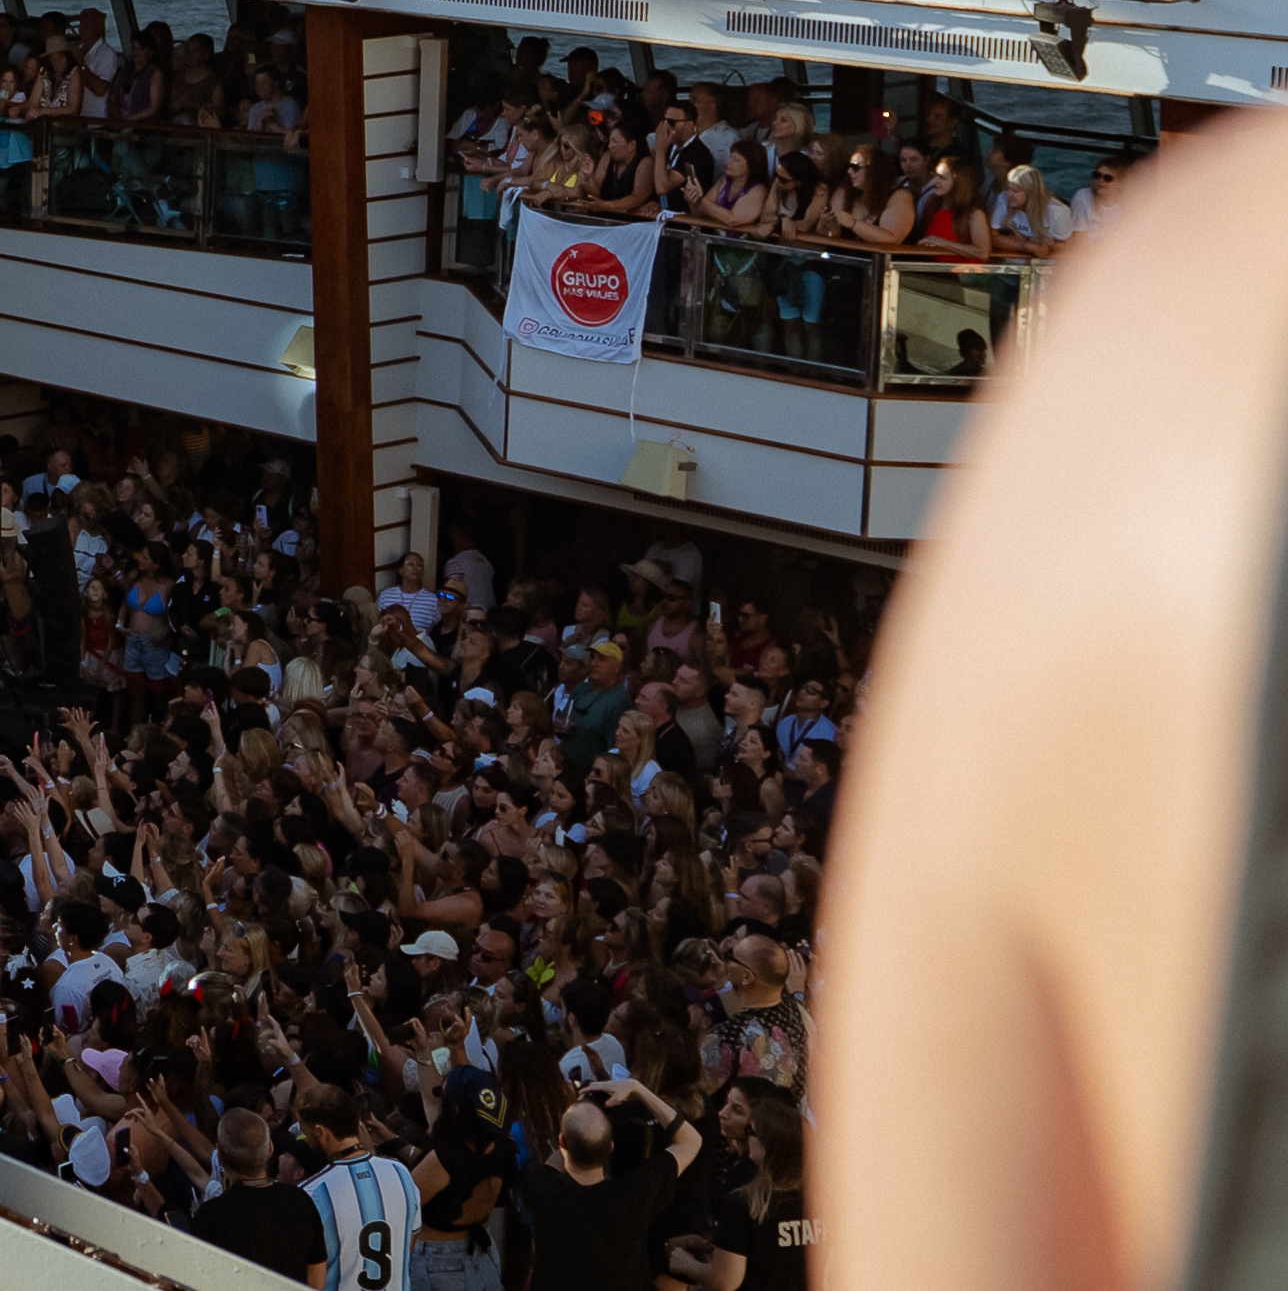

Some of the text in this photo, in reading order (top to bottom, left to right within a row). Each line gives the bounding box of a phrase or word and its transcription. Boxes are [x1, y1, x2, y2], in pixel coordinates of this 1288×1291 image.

[562, 270, 620, 290] GRUPO
[585, 289, 620, 301] VIAJES
[778, 1219, 823, 1247] STAF
[357, 1220, 392, 1291] 9
